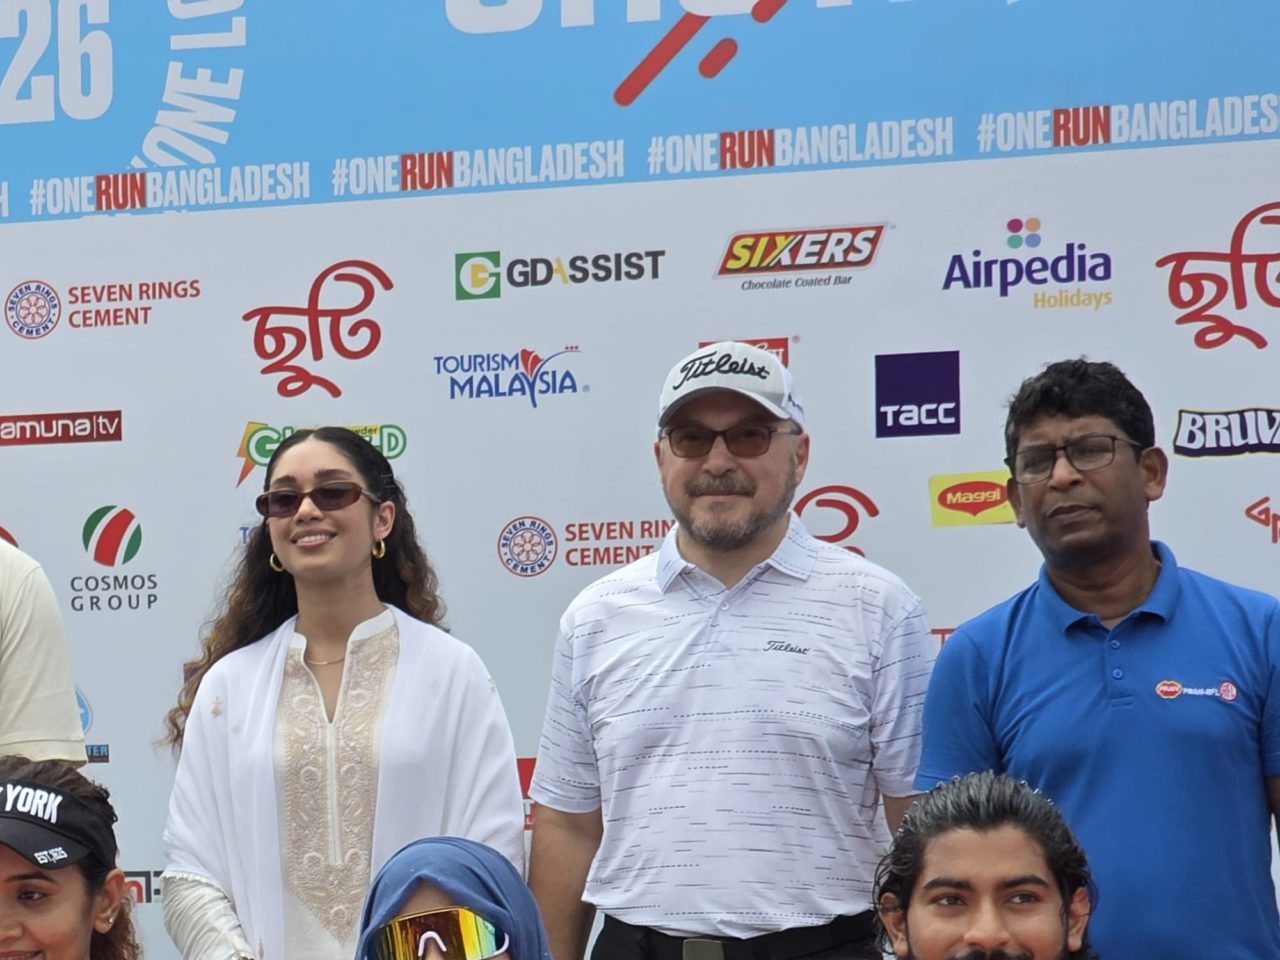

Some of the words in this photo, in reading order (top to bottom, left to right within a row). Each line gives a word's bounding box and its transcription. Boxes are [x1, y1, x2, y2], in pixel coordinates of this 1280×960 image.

[977, 93, 1280, 153] #ONERUNBANGLADES
[648, 116, 953, 175] #ONERUNBANGLADESH
[332, 139, 624, 196] #ONERUNBANGLADESH
[30, 162, 309, 215] #ONERUNBANGLADESH
[726, 230, 877, 269] SIXERS
[741, 278, 791, 291] Chocolate
[795, 276, 830, 288] Coated
[834, 275, 853, 286] Bar
[942, 243, 1112, 296] Airpedia
[68, 284, 133, 304] SEVEN
[138, 280, 201, 300] RINGS
[1033, 289, 1113, 310] Holidays
[69, 306, 152, 328] CEMENT
[434, 352, 520, 375] TOURISM
[673, 351, 770, 390] Titleist
[449, 366, 578, 408] MALAYSIA
[946, 488, 1001, 504] Maggi
[565, 521, 634, 542] SEVEN
[640, 519, 676, 539] RIN
[70, 573, 158, 592] COSMOS
[70, 593, 158, 612] GROUP
[4, 783, 64, 824] YORK
